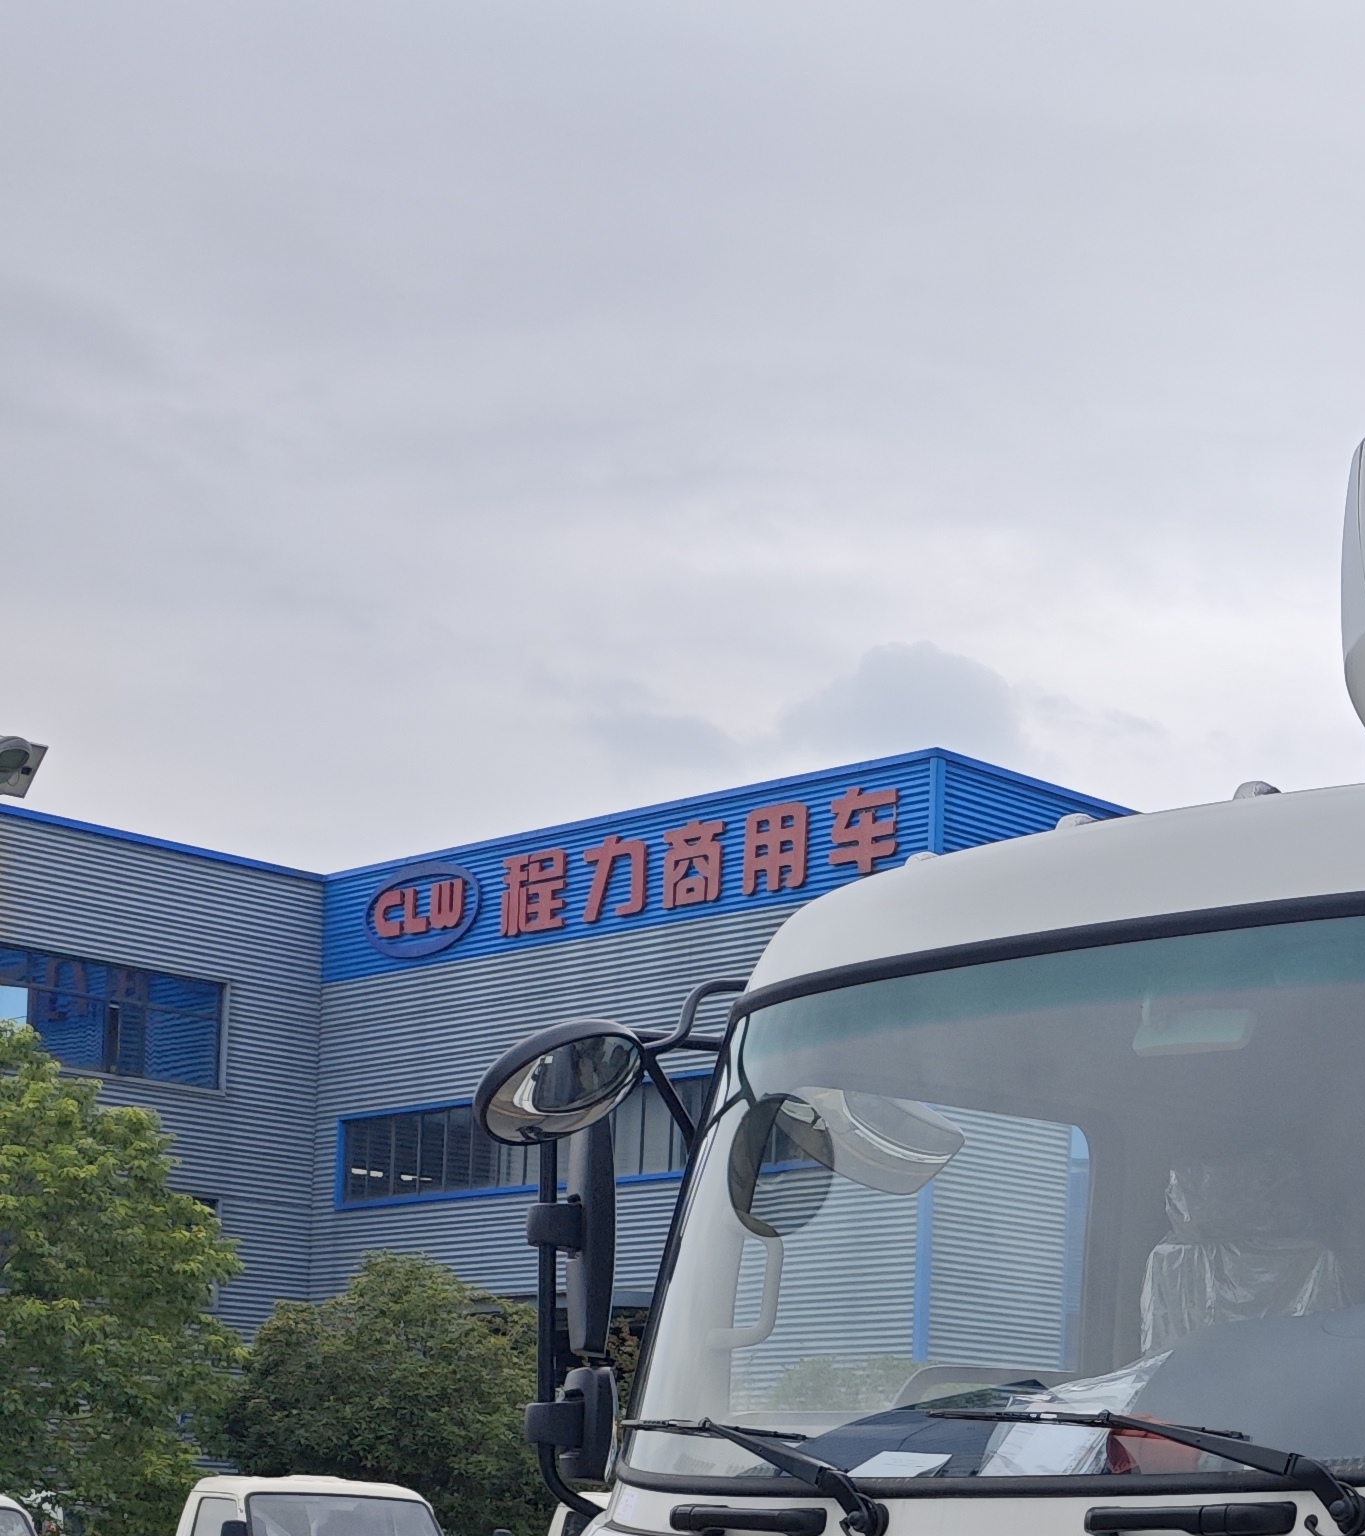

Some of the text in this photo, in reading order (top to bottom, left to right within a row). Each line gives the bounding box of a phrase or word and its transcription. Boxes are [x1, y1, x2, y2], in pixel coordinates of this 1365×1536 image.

[373, 876, 466, 939] CLW
[500, 786, 899, 937] 程力商用车
